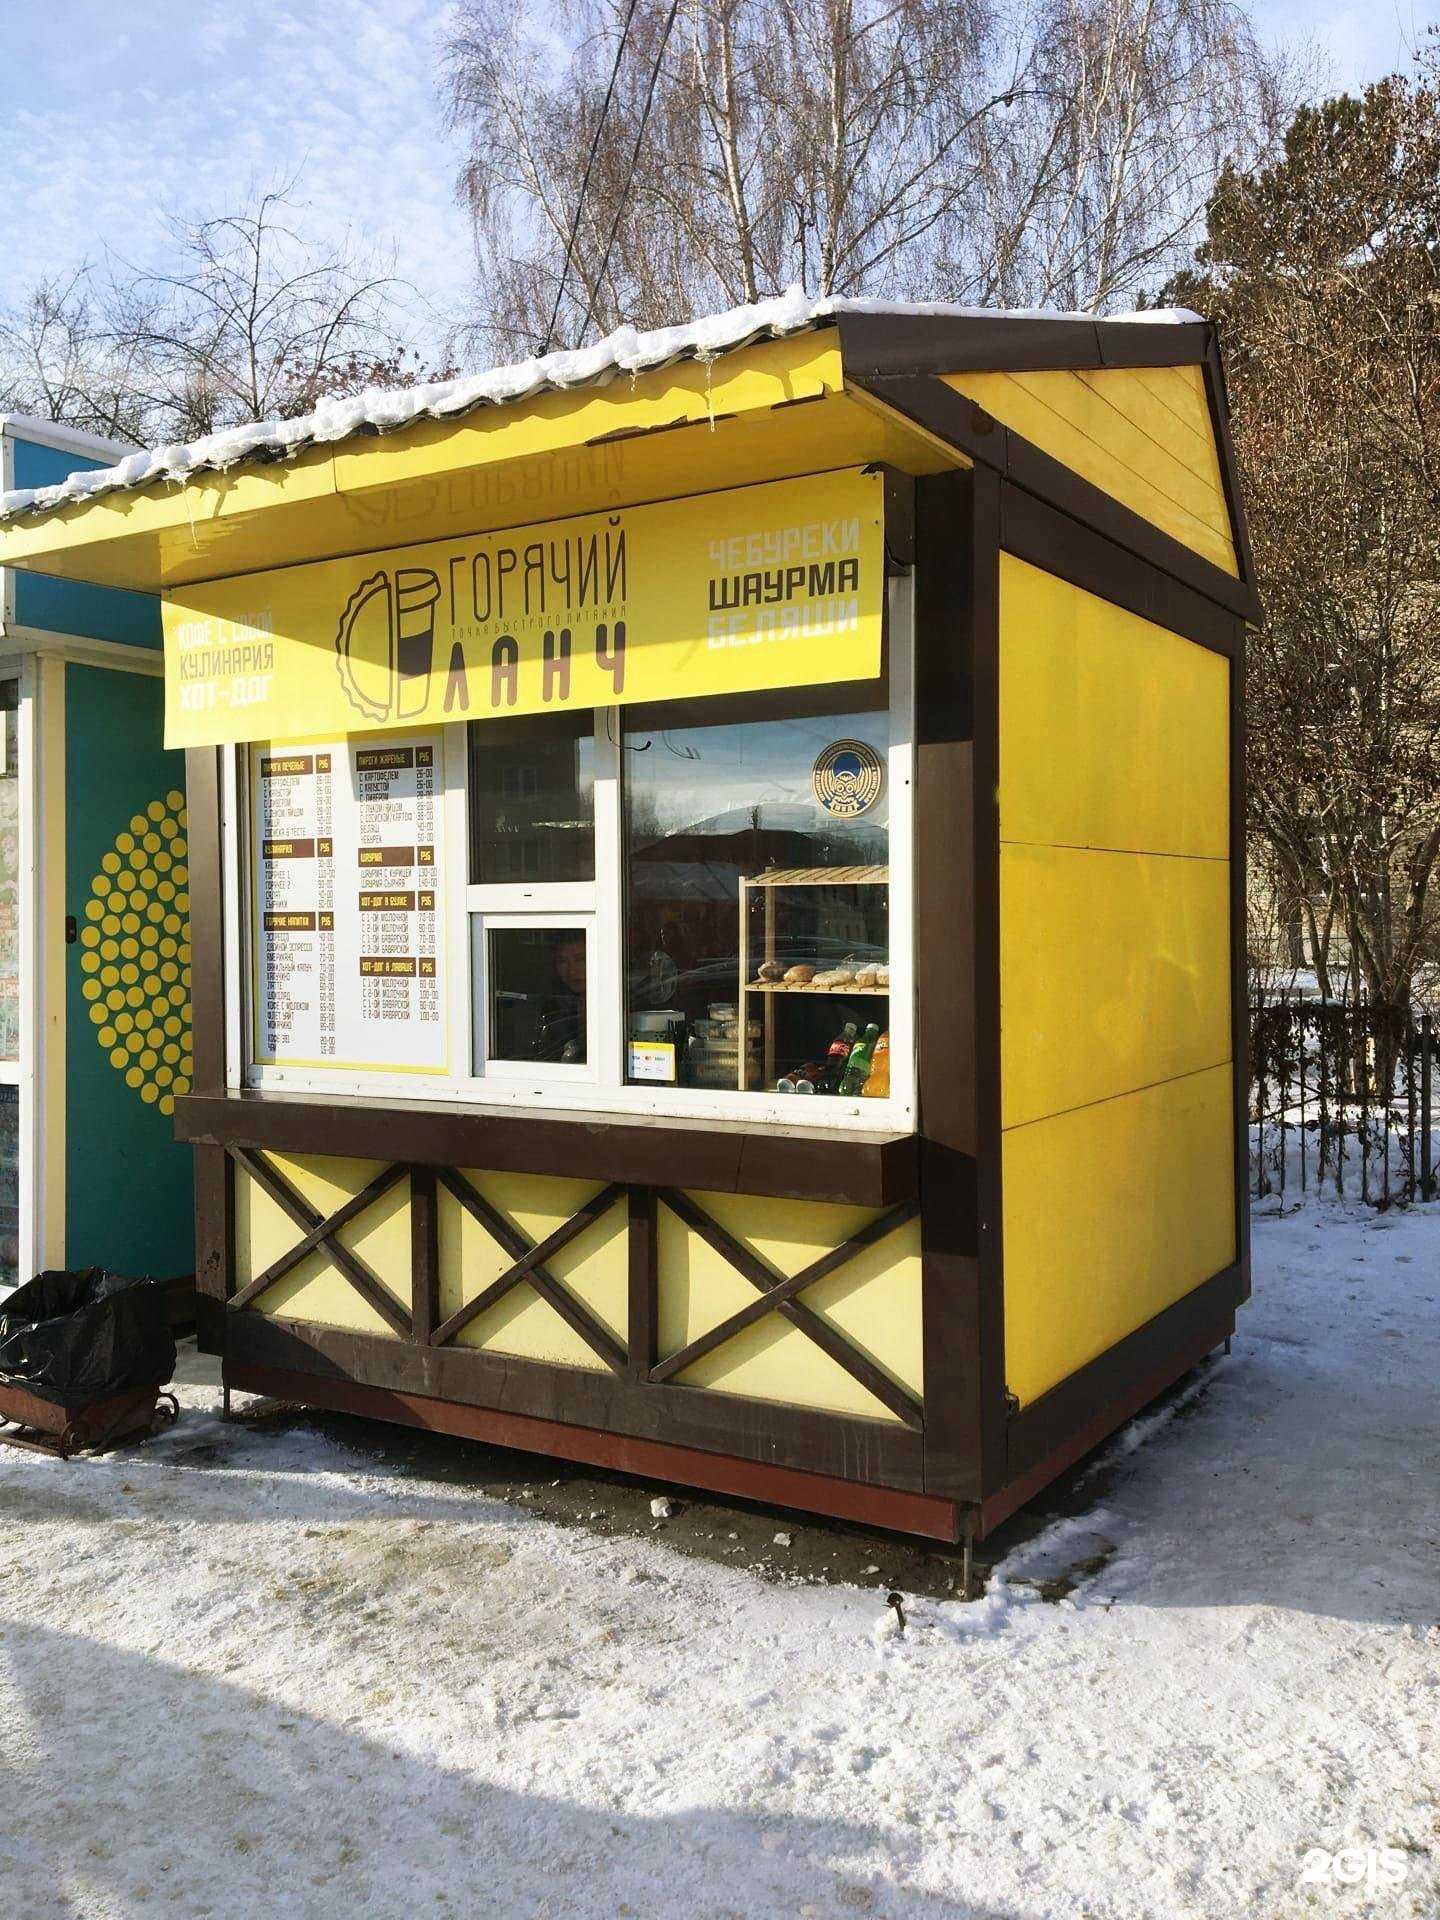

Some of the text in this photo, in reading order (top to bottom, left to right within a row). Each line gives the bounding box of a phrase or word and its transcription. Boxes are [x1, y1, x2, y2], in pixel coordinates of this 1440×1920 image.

[709, 517, 859, 571] ЧЕБУРЕКИ
[450, 515, 626, 625] ГОРЯЧИЙ
[709, 558, 859, 611] ШАУРМА
[178, 620, 211, 650] КОФЕ
[217, 621, 226, 643] С
[451, 606, 626, 639] ТОЧКА БЫСТРОГО ПИТАНИЯ
[708, 597, 859, 650] БЕЛЯШИ
[180, 643, 273, 681] КУЛИНАРИЯ
[443, 621, 627, 713] ЛАНЧ
[180, 674, 272, 711] ХОТ-ДОГ
[364, 771, 399, 782] КАРТОФЕЛЕМ
[364, 782, 390, 792] КАПУСТОЙ
[420, 851, 431, 861] РУБ
[421, 897, 432, 906] РУБ
[422, 963, 432, 972] РУБ
